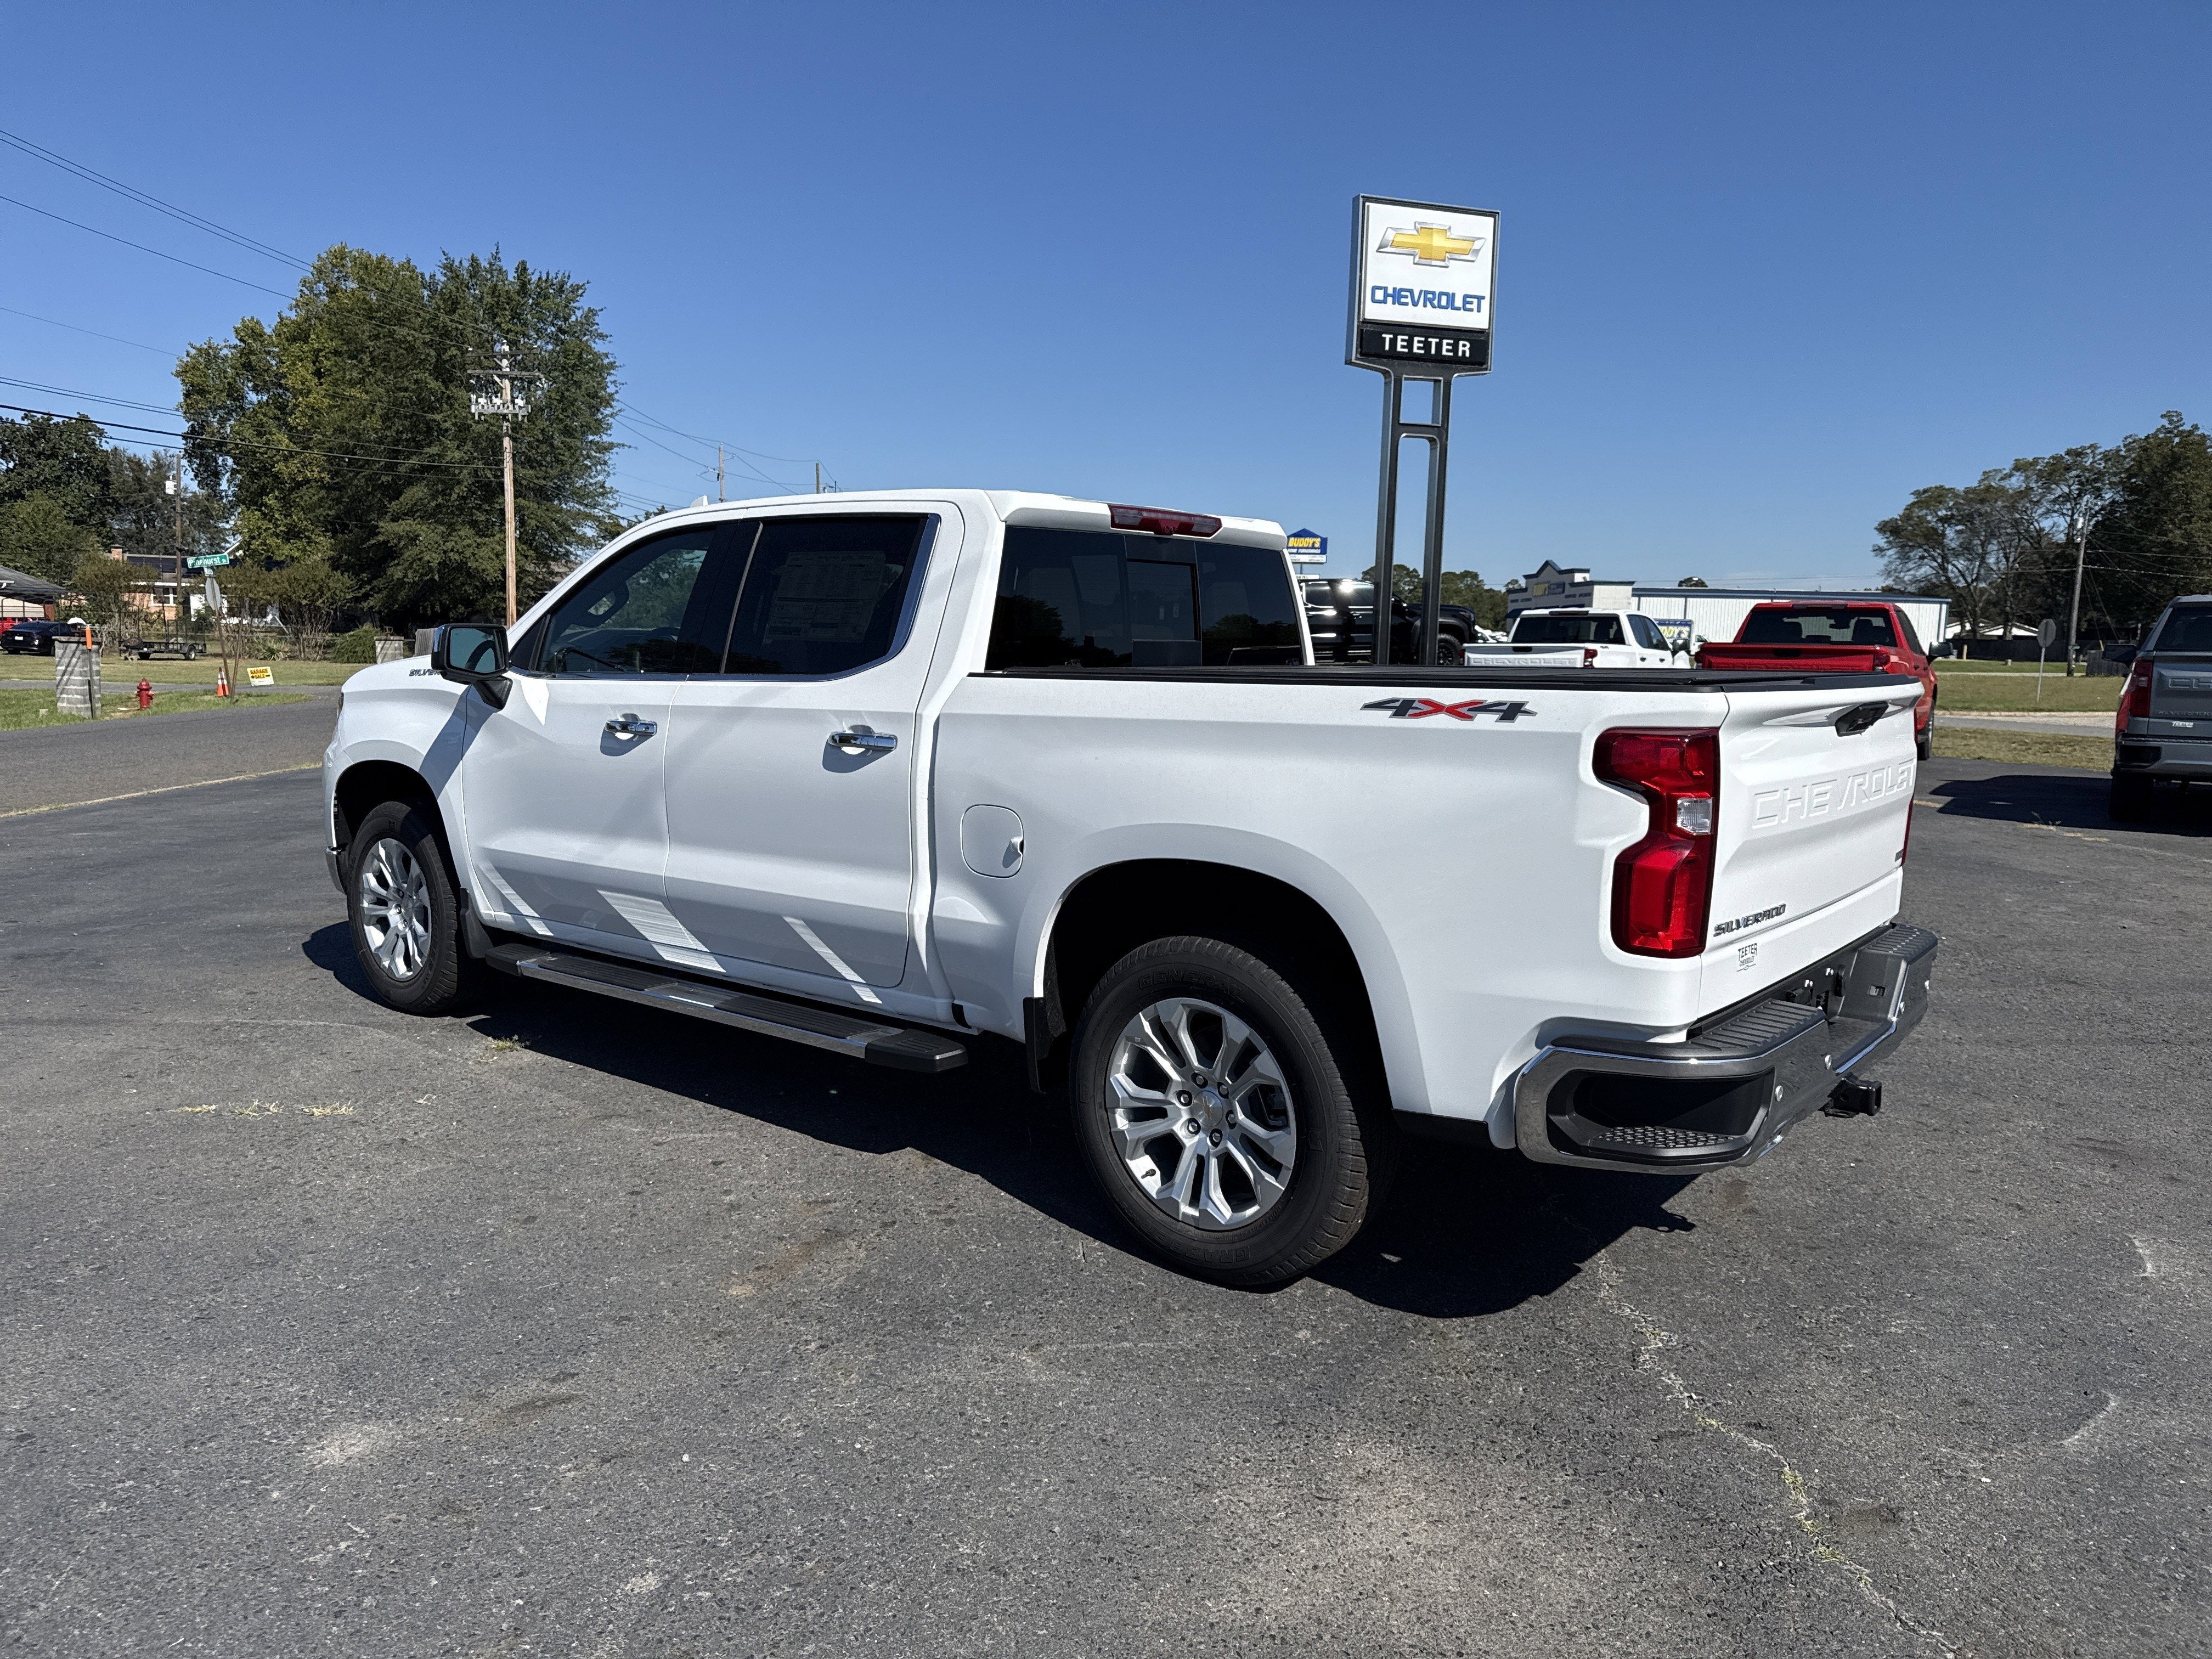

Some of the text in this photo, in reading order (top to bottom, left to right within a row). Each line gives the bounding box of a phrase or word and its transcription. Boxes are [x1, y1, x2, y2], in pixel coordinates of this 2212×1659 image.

[1371, 285, 1486, 313] CHEVROLET
[1381, 334, 1471, 358] TEETER
[1288, 537, 1321, 548] BUDDY'S
[1658, 626, 1690, 638] DDY'S
[1752, 758, 1916, 829] CHEVROLET
[1713, 903, 1786, 937] SILVERADO
[1737, 943, 1758, 961] TEETER
[1138, 969, 1245, 1003] GENERAL
